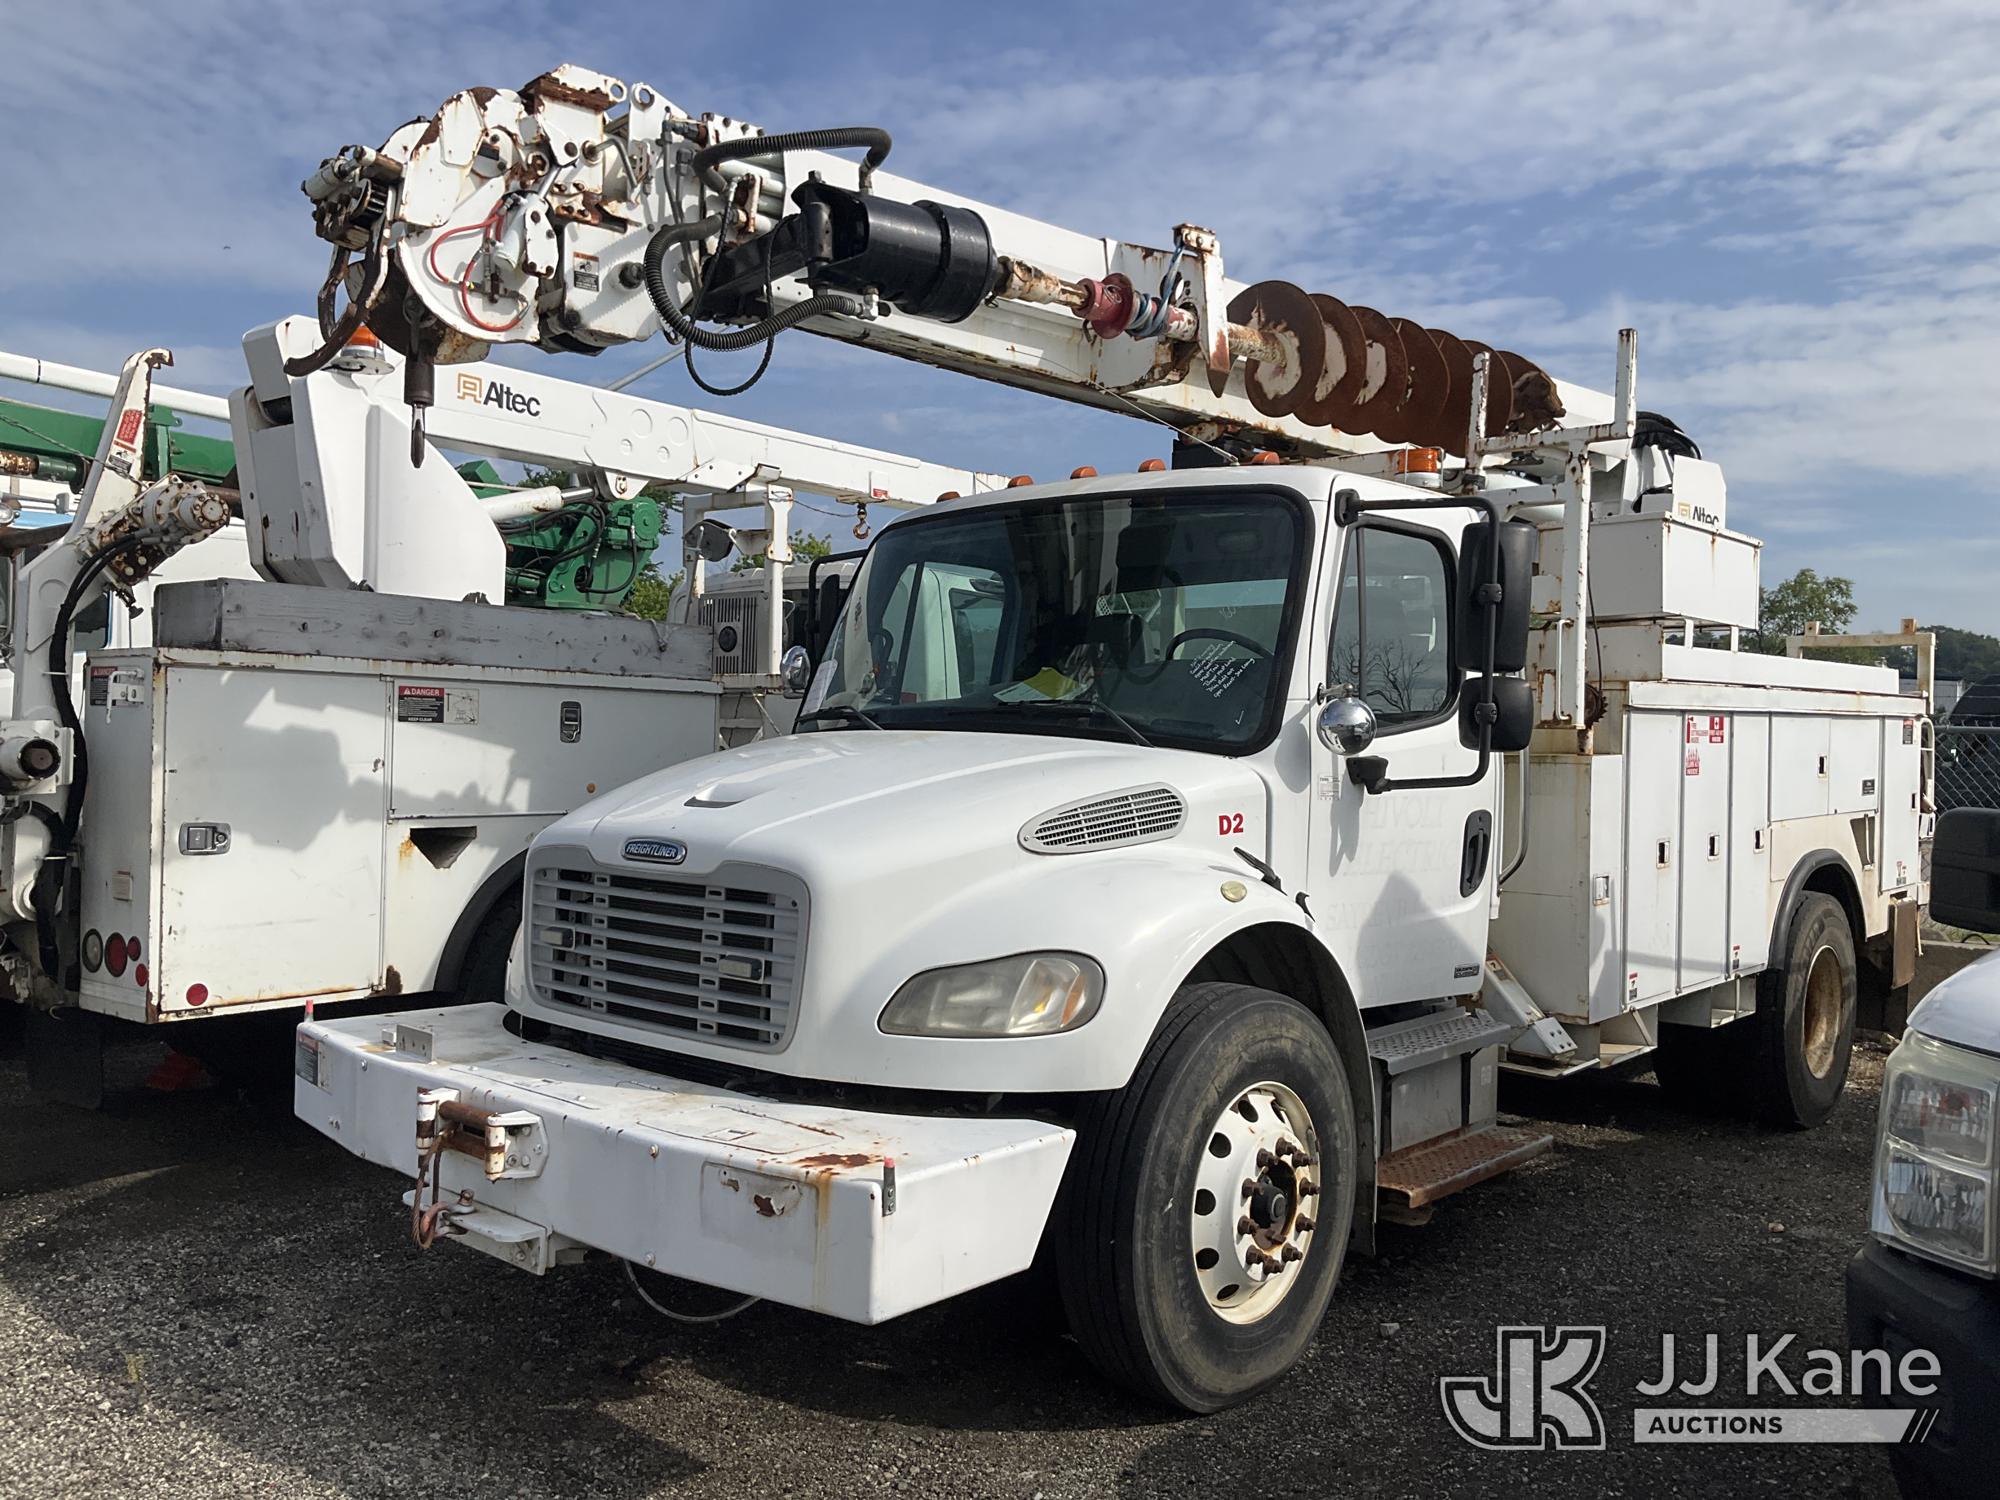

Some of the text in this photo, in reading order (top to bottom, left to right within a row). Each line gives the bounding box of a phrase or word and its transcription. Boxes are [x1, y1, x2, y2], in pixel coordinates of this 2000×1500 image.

[483, 381, 541, 417] Altec
[411, 688, 440, 696] DANGER
[1218, 813, 1244, 836] D2
[626, 843, 677, 858] FREIGHTLINER
